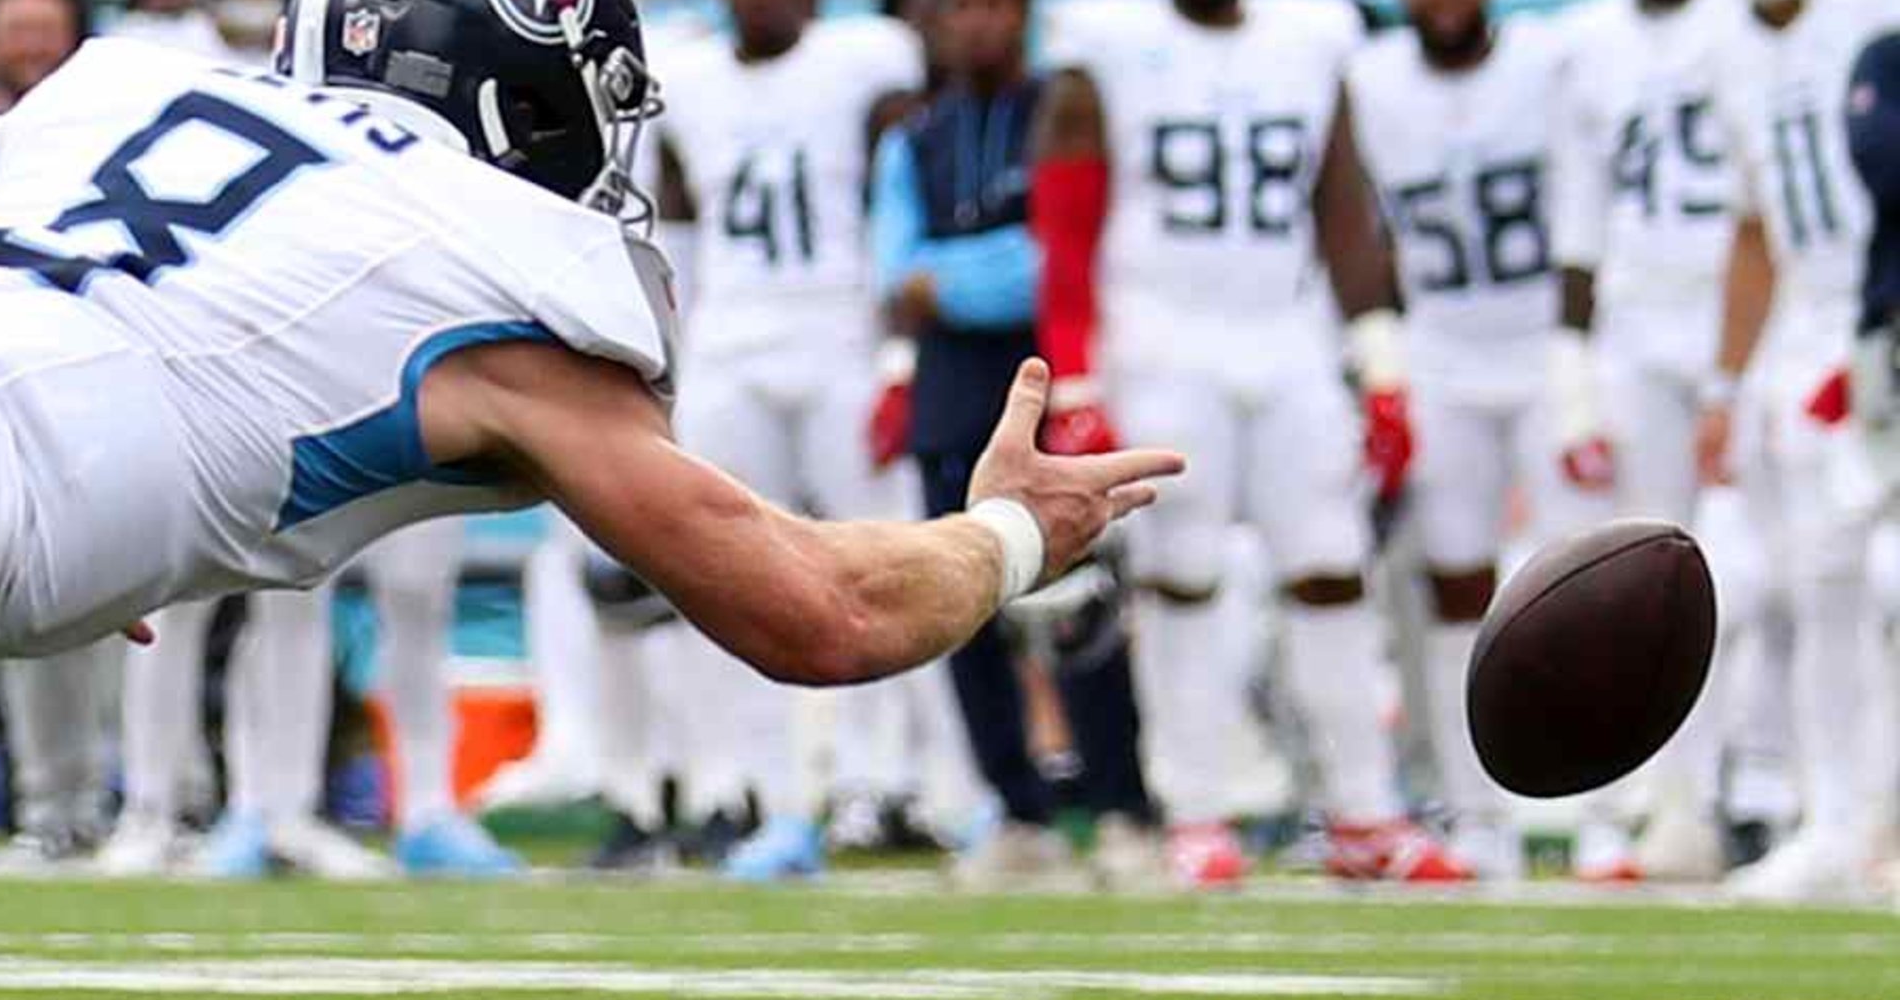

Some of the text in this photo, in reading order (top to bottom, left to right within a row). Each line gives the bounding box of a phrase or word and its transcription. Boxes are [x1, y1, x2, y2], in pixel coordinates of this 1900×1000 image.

[722, 148, 813, 266] 41
[1152, 117, 1303, 235] 98
[1397, 156, 1549, 293] 58
[1773, 111, 1837, 250] 11
